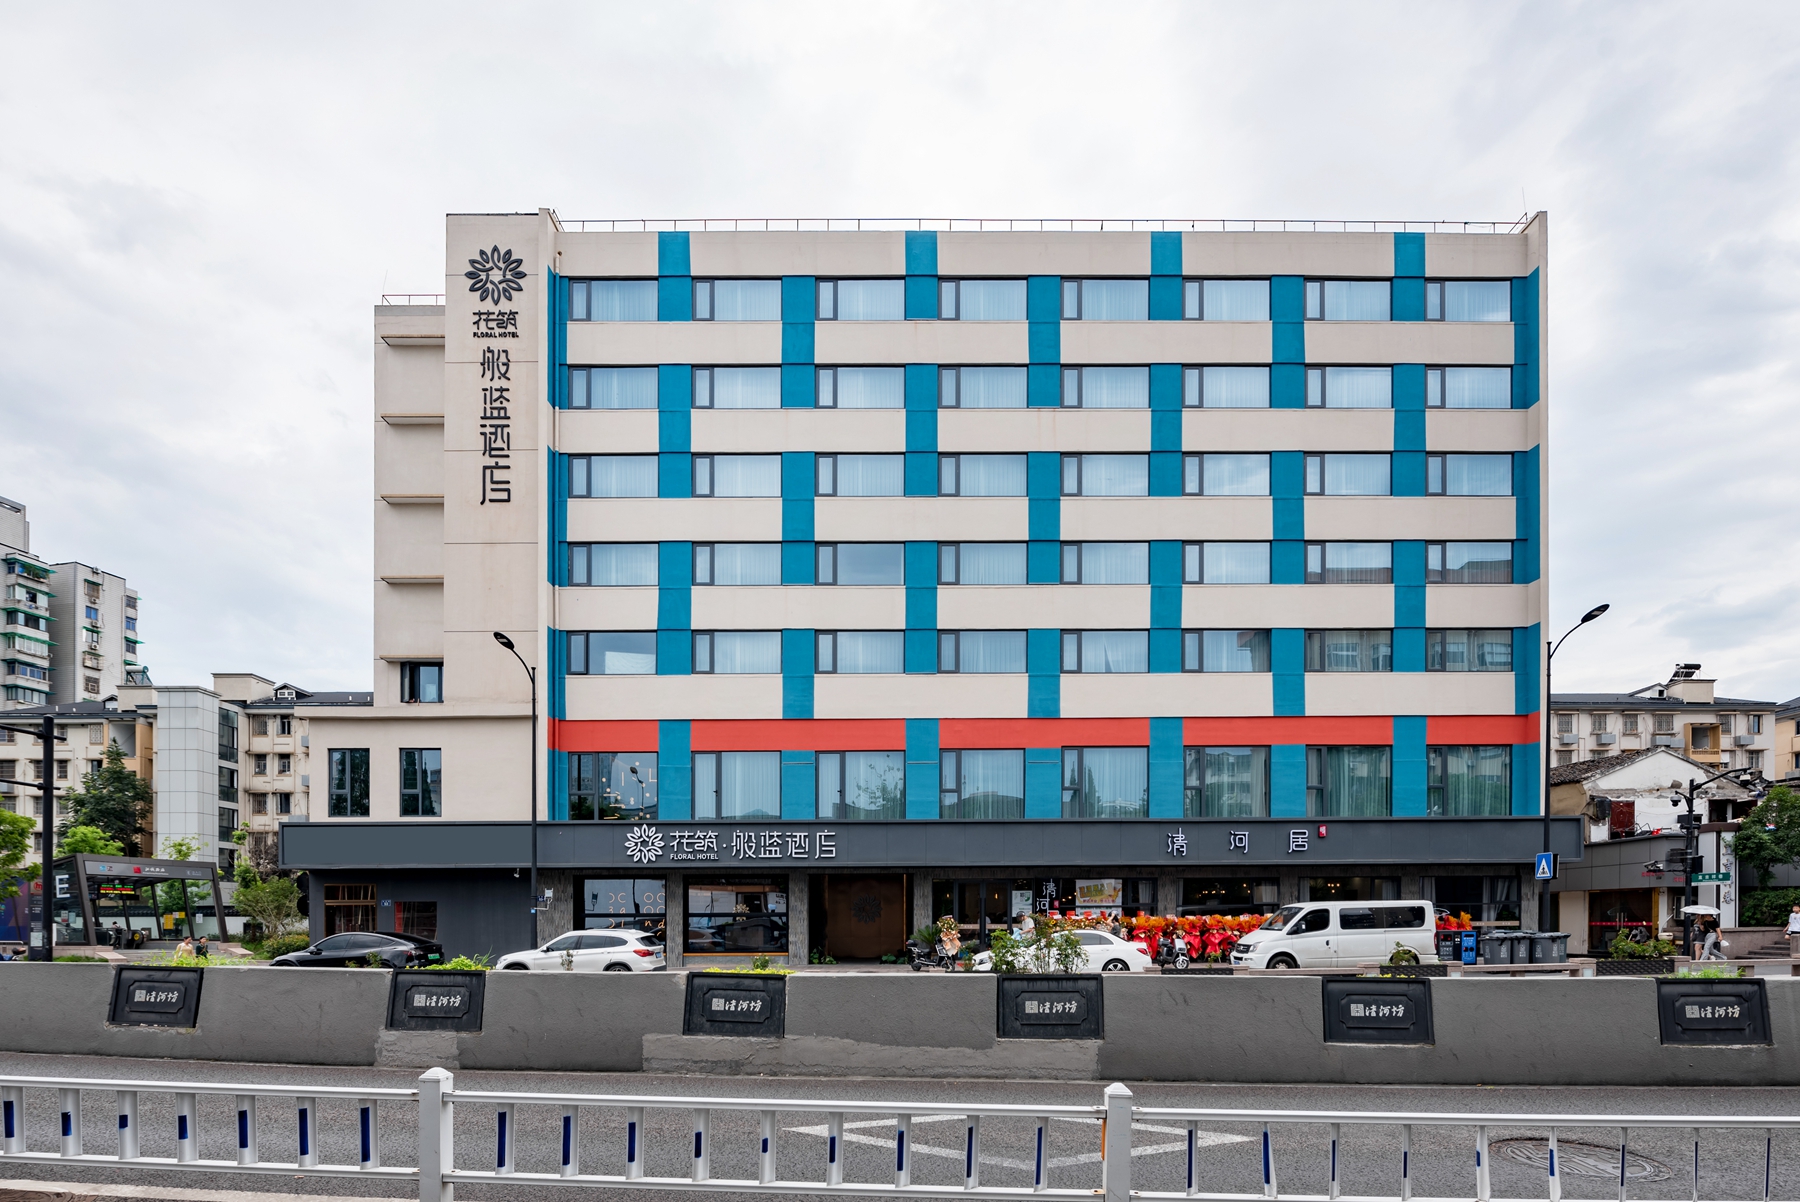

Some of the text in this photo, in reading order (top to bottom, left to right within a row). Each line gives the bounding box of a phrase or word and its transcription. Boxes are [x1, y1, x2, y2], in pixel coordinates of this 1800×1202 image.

[472, 309, 519, 330] 花筑
[1167, 827, 1308, 856] 清河居
[55, 874, 71, 898] E
